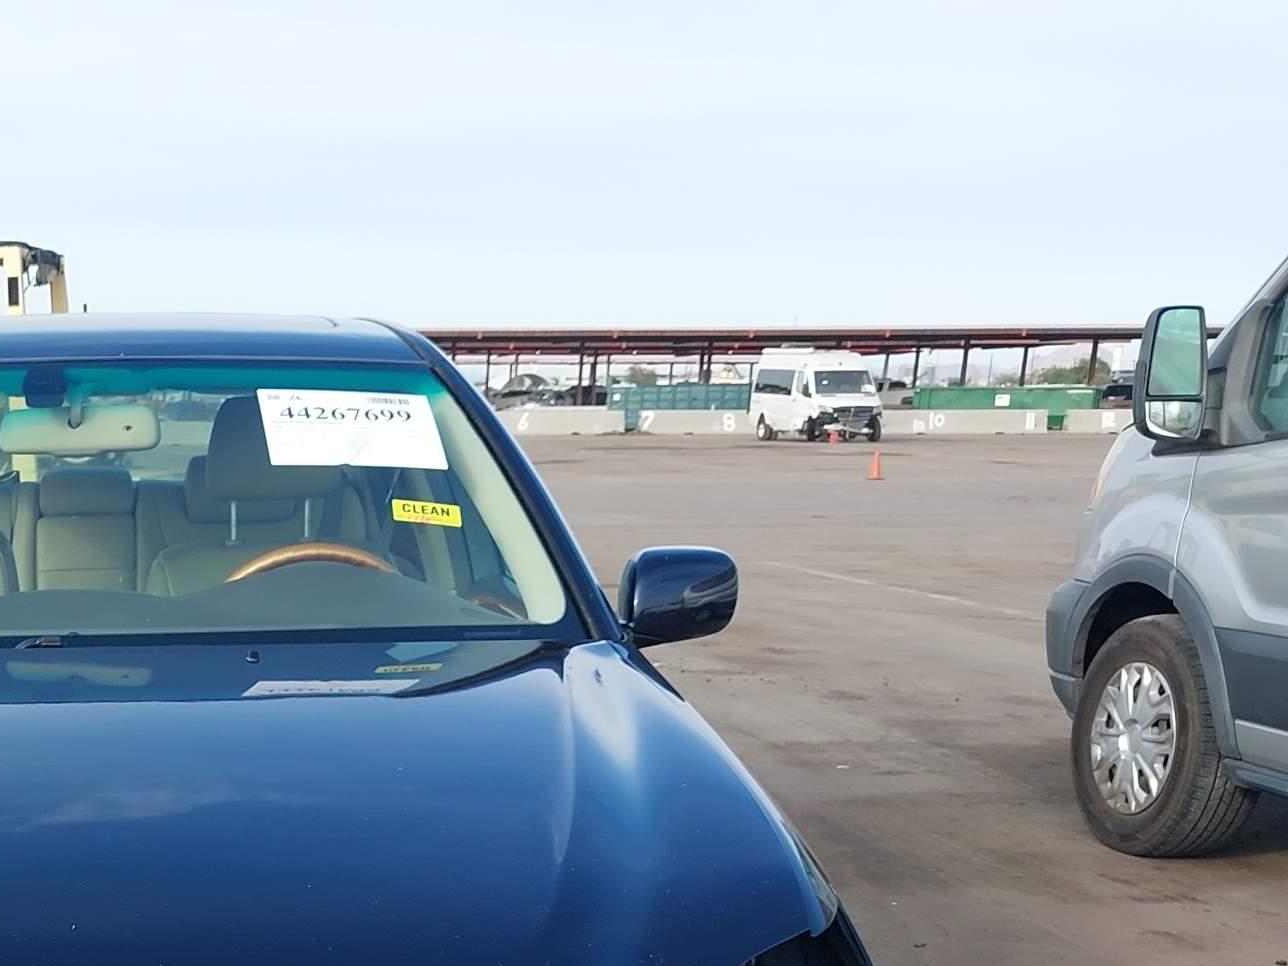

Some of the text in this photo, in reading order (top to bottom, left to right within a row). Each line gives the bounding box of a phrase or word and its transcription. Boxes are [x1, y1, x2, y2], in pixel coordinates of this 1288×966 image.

[279, 405, 412, 422] 44267699
[517, 411, 529, 432] 6
[638, 411, 655, 431] 7
[722, 412, 736, 432] 8
[929, 411, 945, 430] 10
[401, 503, 450, 517] CLEAN
